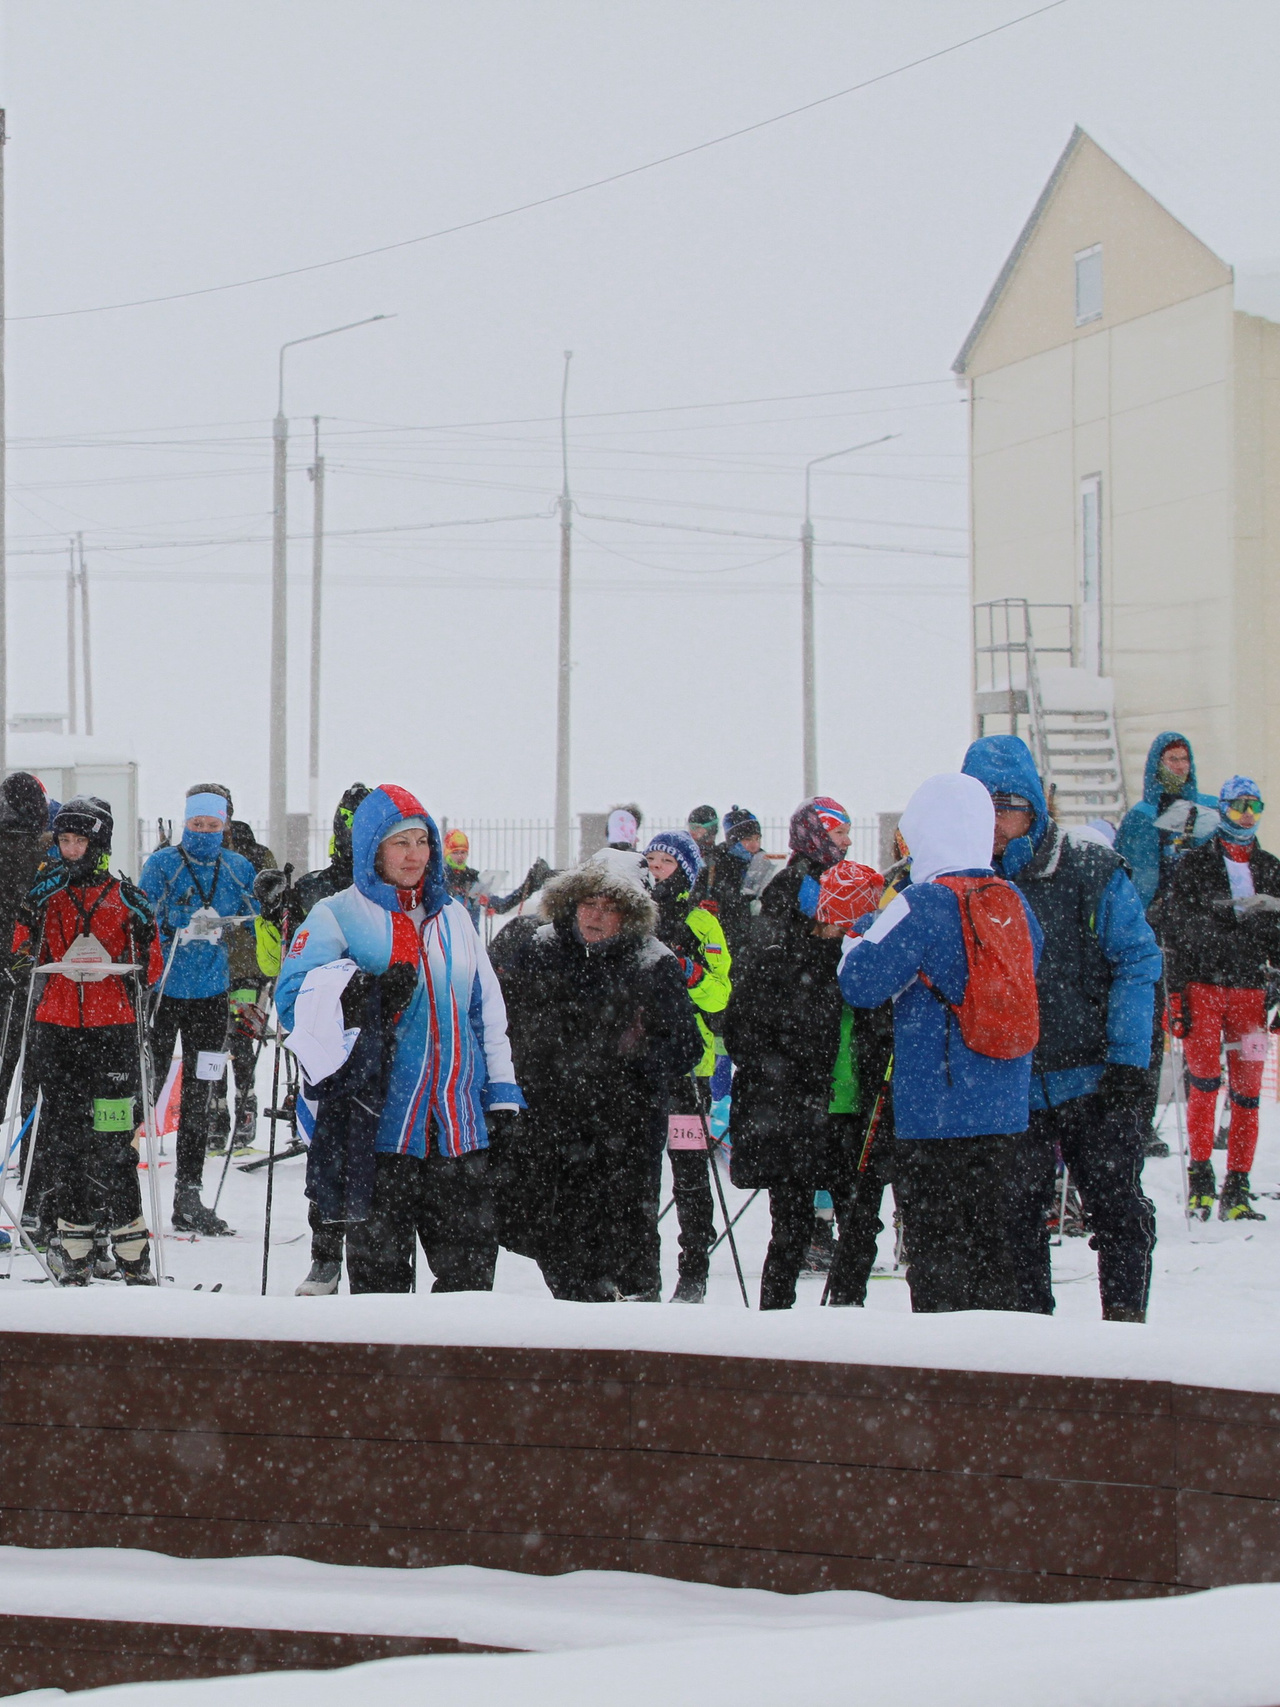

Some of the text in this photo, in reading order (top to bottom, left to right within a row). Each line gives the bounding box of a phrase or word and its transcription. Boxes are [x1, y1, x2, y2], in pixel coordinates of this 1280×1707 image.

[106, 1072, 130, 1081] RAY
[96, 1110, 125, 1121] 214.2
[673, 1127, 704, 1139] 216.3
